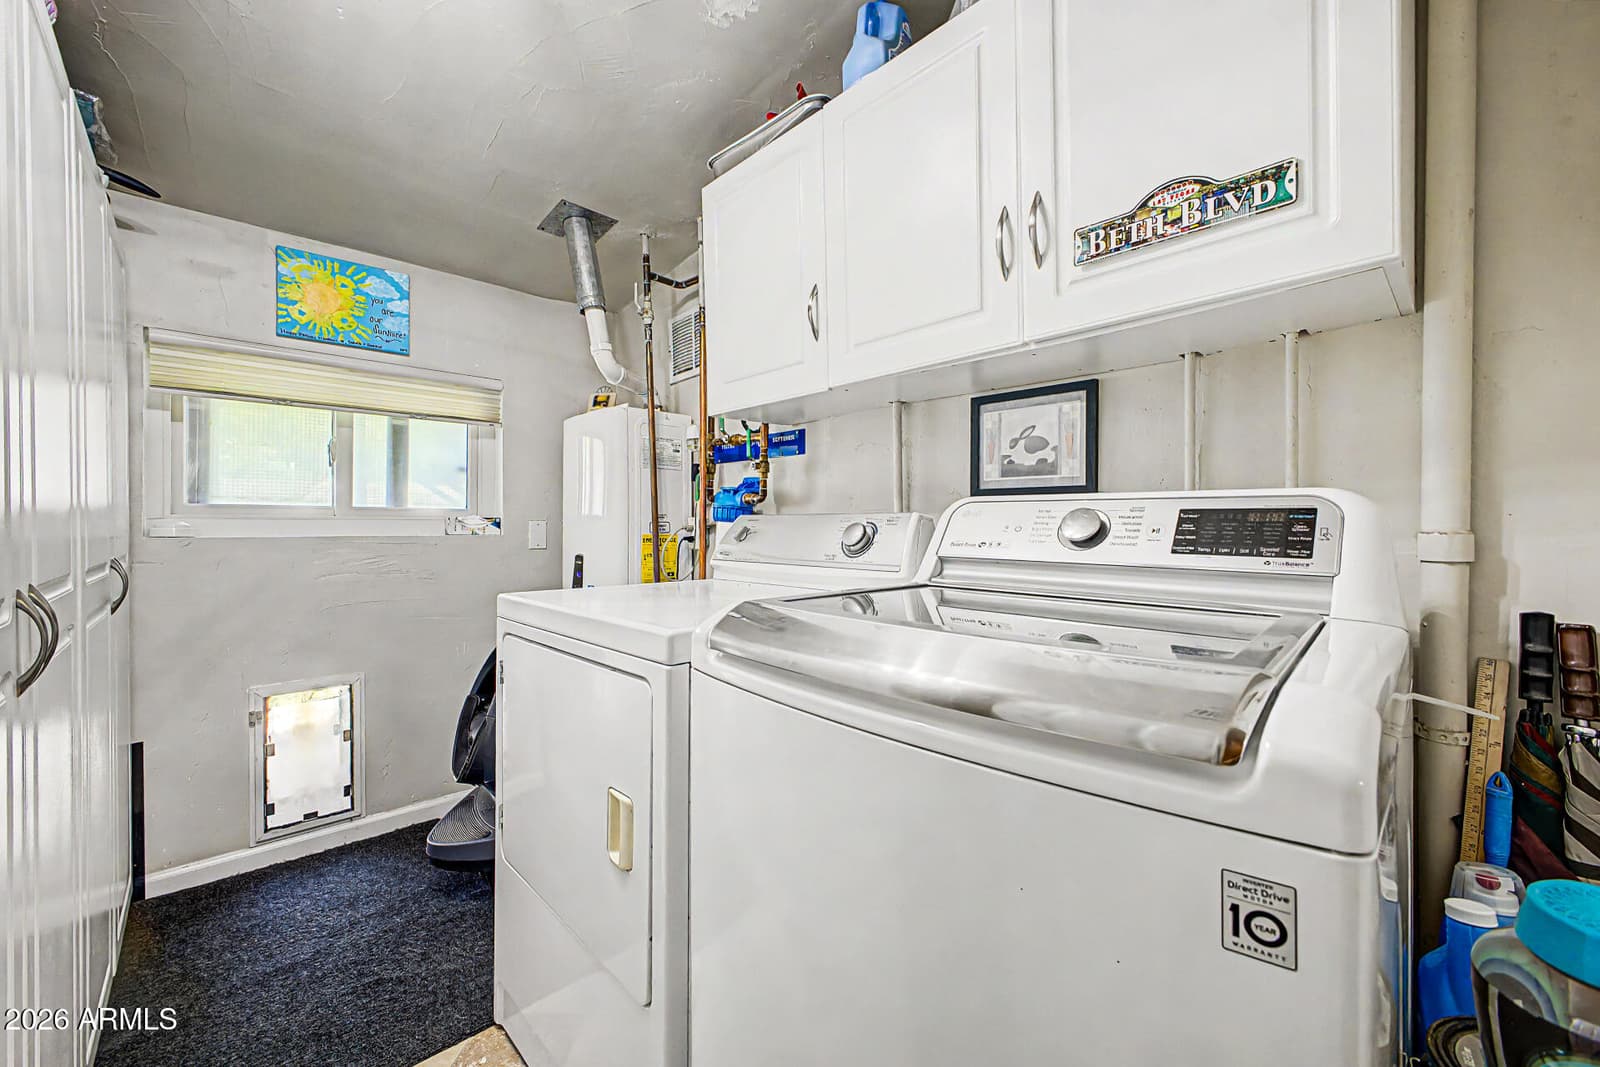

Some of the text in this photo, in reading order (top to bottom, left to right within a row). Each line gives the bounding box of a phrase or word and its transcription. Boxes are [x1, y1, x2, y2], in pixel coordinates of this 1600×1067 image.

[1089, 179, 1278, 257] BETH BLVD
[370, 316, 383, 325] our
[381, 308, 394, 317] are
[1227, 880, 1290, 904] Direct Drive
[1229, 902, 1288, 948] 10
[1254, 923, 1277, 936] YEAR
